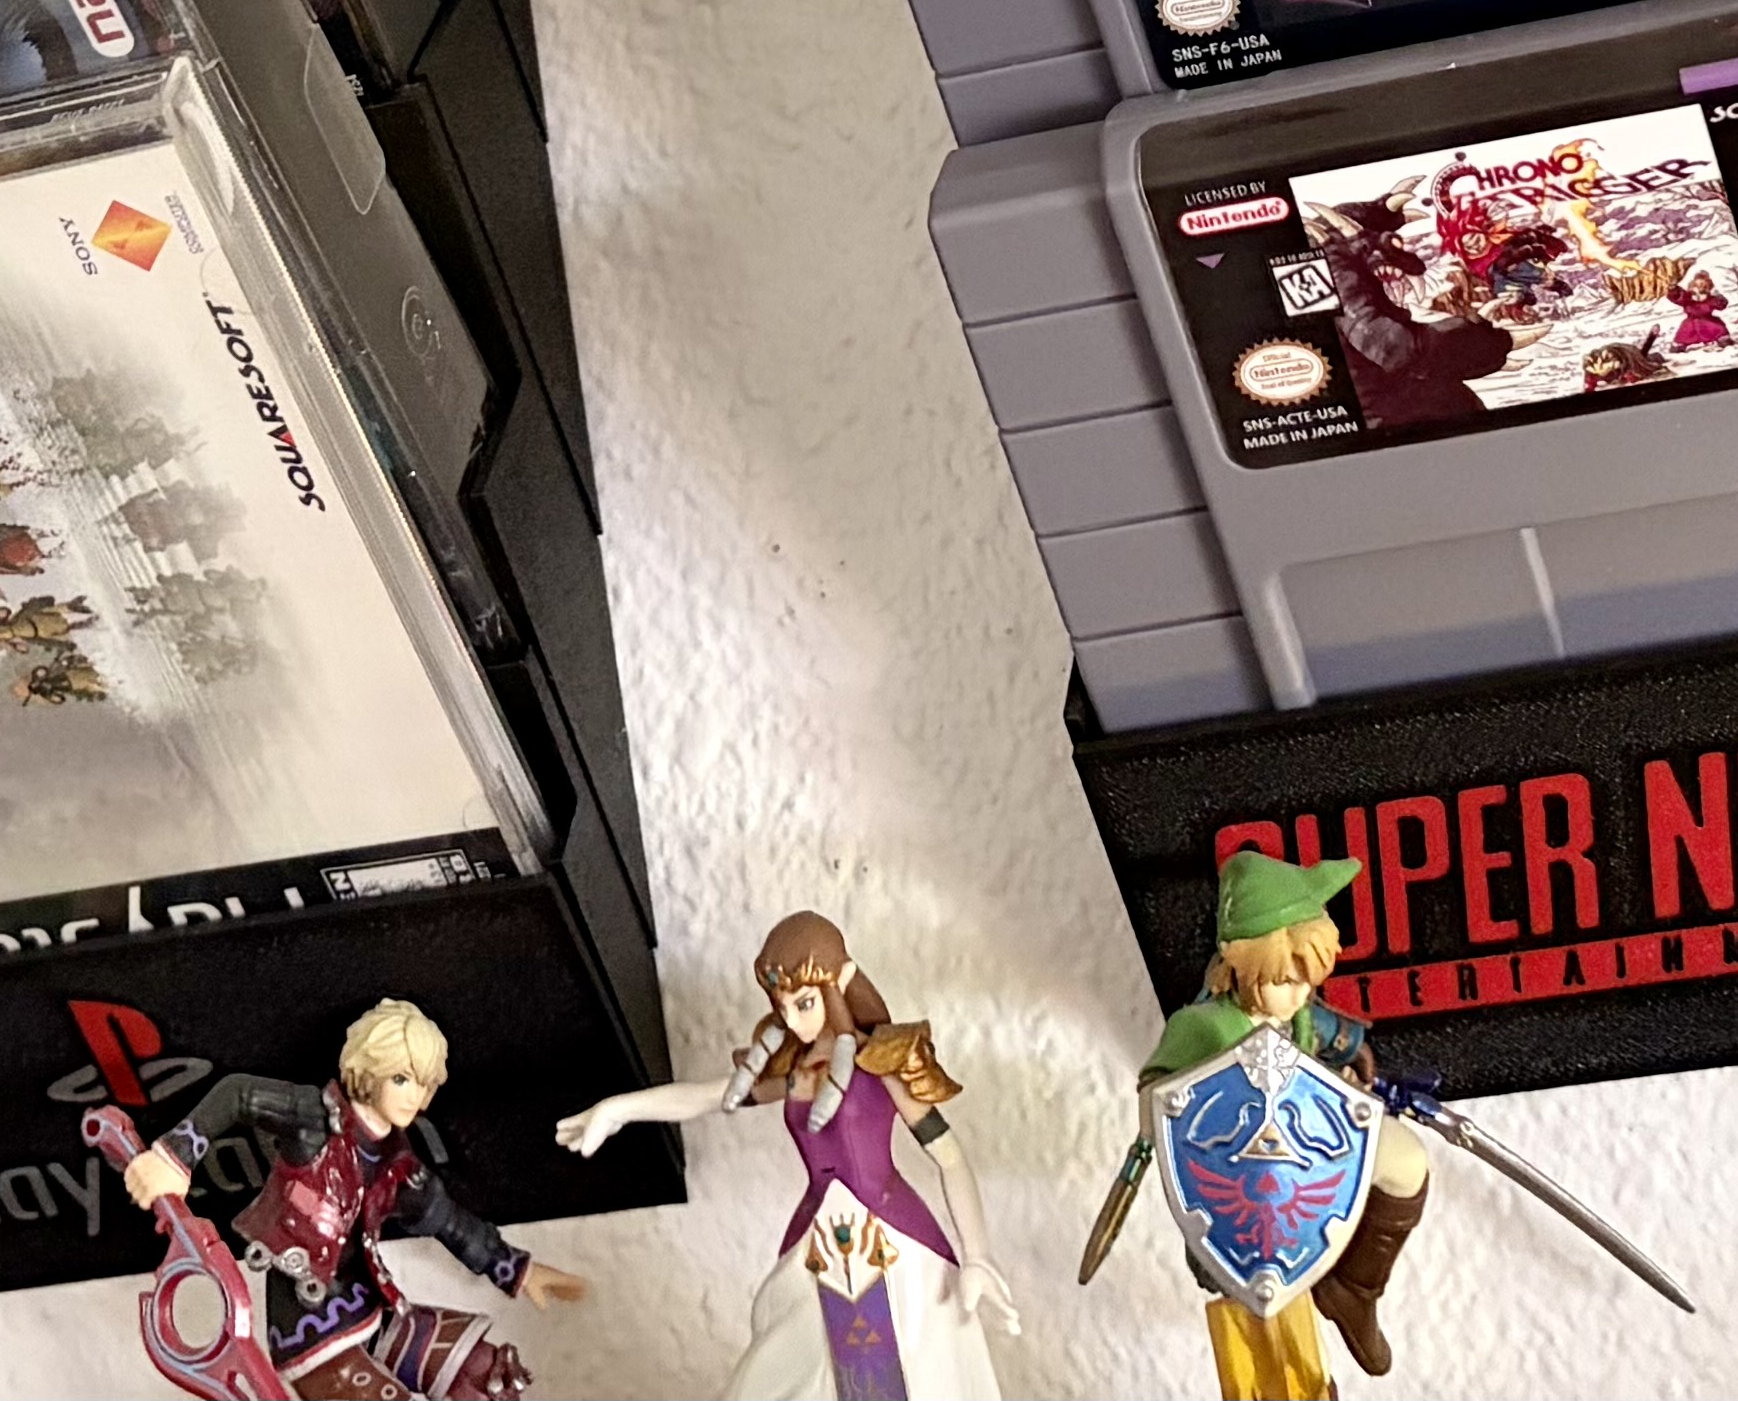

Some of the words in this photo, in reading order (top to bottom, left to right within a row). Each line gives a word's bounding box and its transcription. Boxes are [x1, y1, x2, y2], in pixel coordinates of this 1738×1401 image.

[1171, 33, 1271, 64] SNS-F6-USA
[1174, 60, 1209, 79] MADE
[1217, 57, 1234, 71] IN
[1240, 48, 1283, 68] JAPAN
[1184, 183, 1249, 207] LICENSED
[1249, 180, 1266, 195] BY
[1433, 148, 1584, 212] CHRONO
[1187, 199, 1282, 231] Nintendo
[59, 215, 98, 277] SONY
[205, 298, 326, 513] SQUARESOFT
[1242, 404, 1349, 433] SNS-ACTE-USA
[1243, 428, 1289, 450] MADE
[1291, 427, 1308, 442] IN
[1310, 420, 1359, 440] JAPAN
